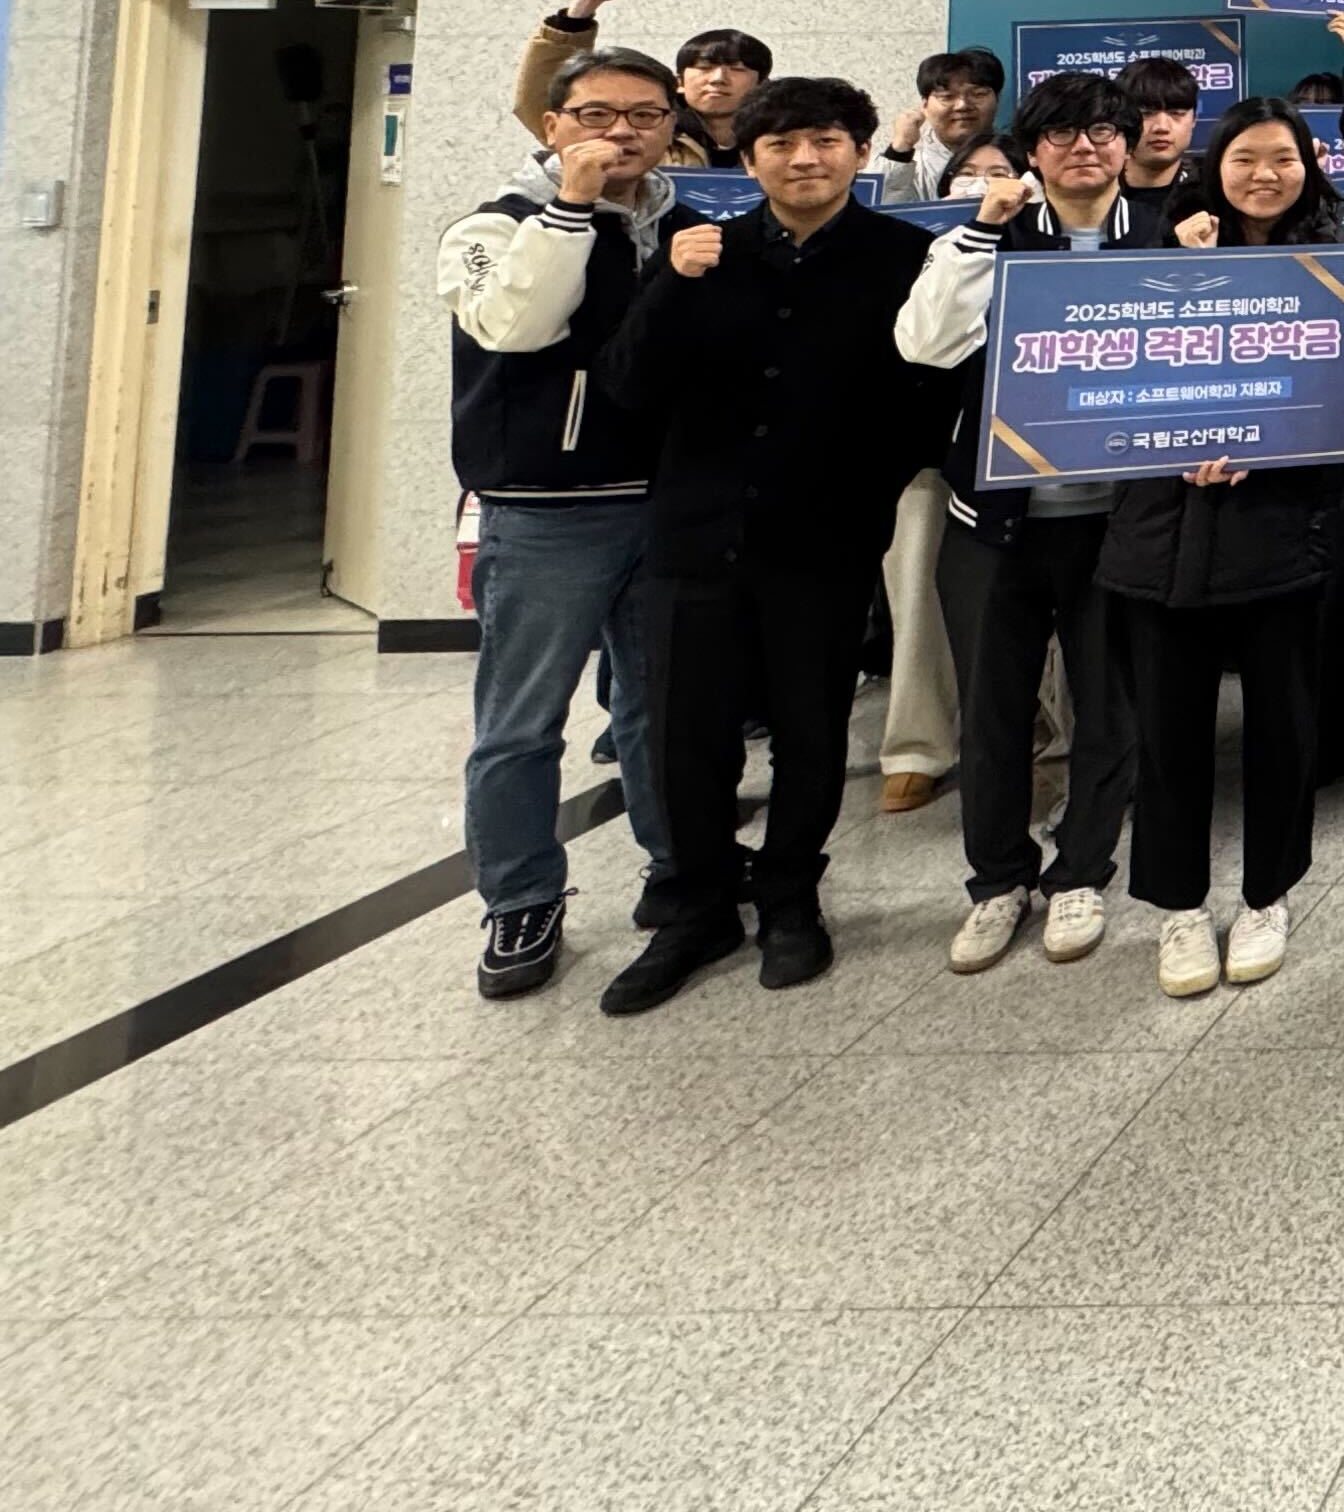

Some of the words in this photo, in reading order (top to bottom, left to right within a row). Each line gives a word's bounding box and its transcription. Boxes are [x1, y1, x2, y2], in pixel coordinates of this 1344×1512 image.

[1056, 50, 1125, 65] 2025학년도
[1065, 301, 1176, 323] 2025학년도
[1178, 296, 1301, 319] 소프트웨어학과
[1013, 327, 1139, 373] 재학생
[1145, 323, 1224, 366] 격려
[1230, 319, 1342, 364] 장학금
[1079, 389, 1126, 407] 대상자
[1136, 384, 1237, 404] 소프트웨어학과
[1239, 381, 1283, 399] 지원자
[1132, 424, 1262, 449] 국립군산대학교
